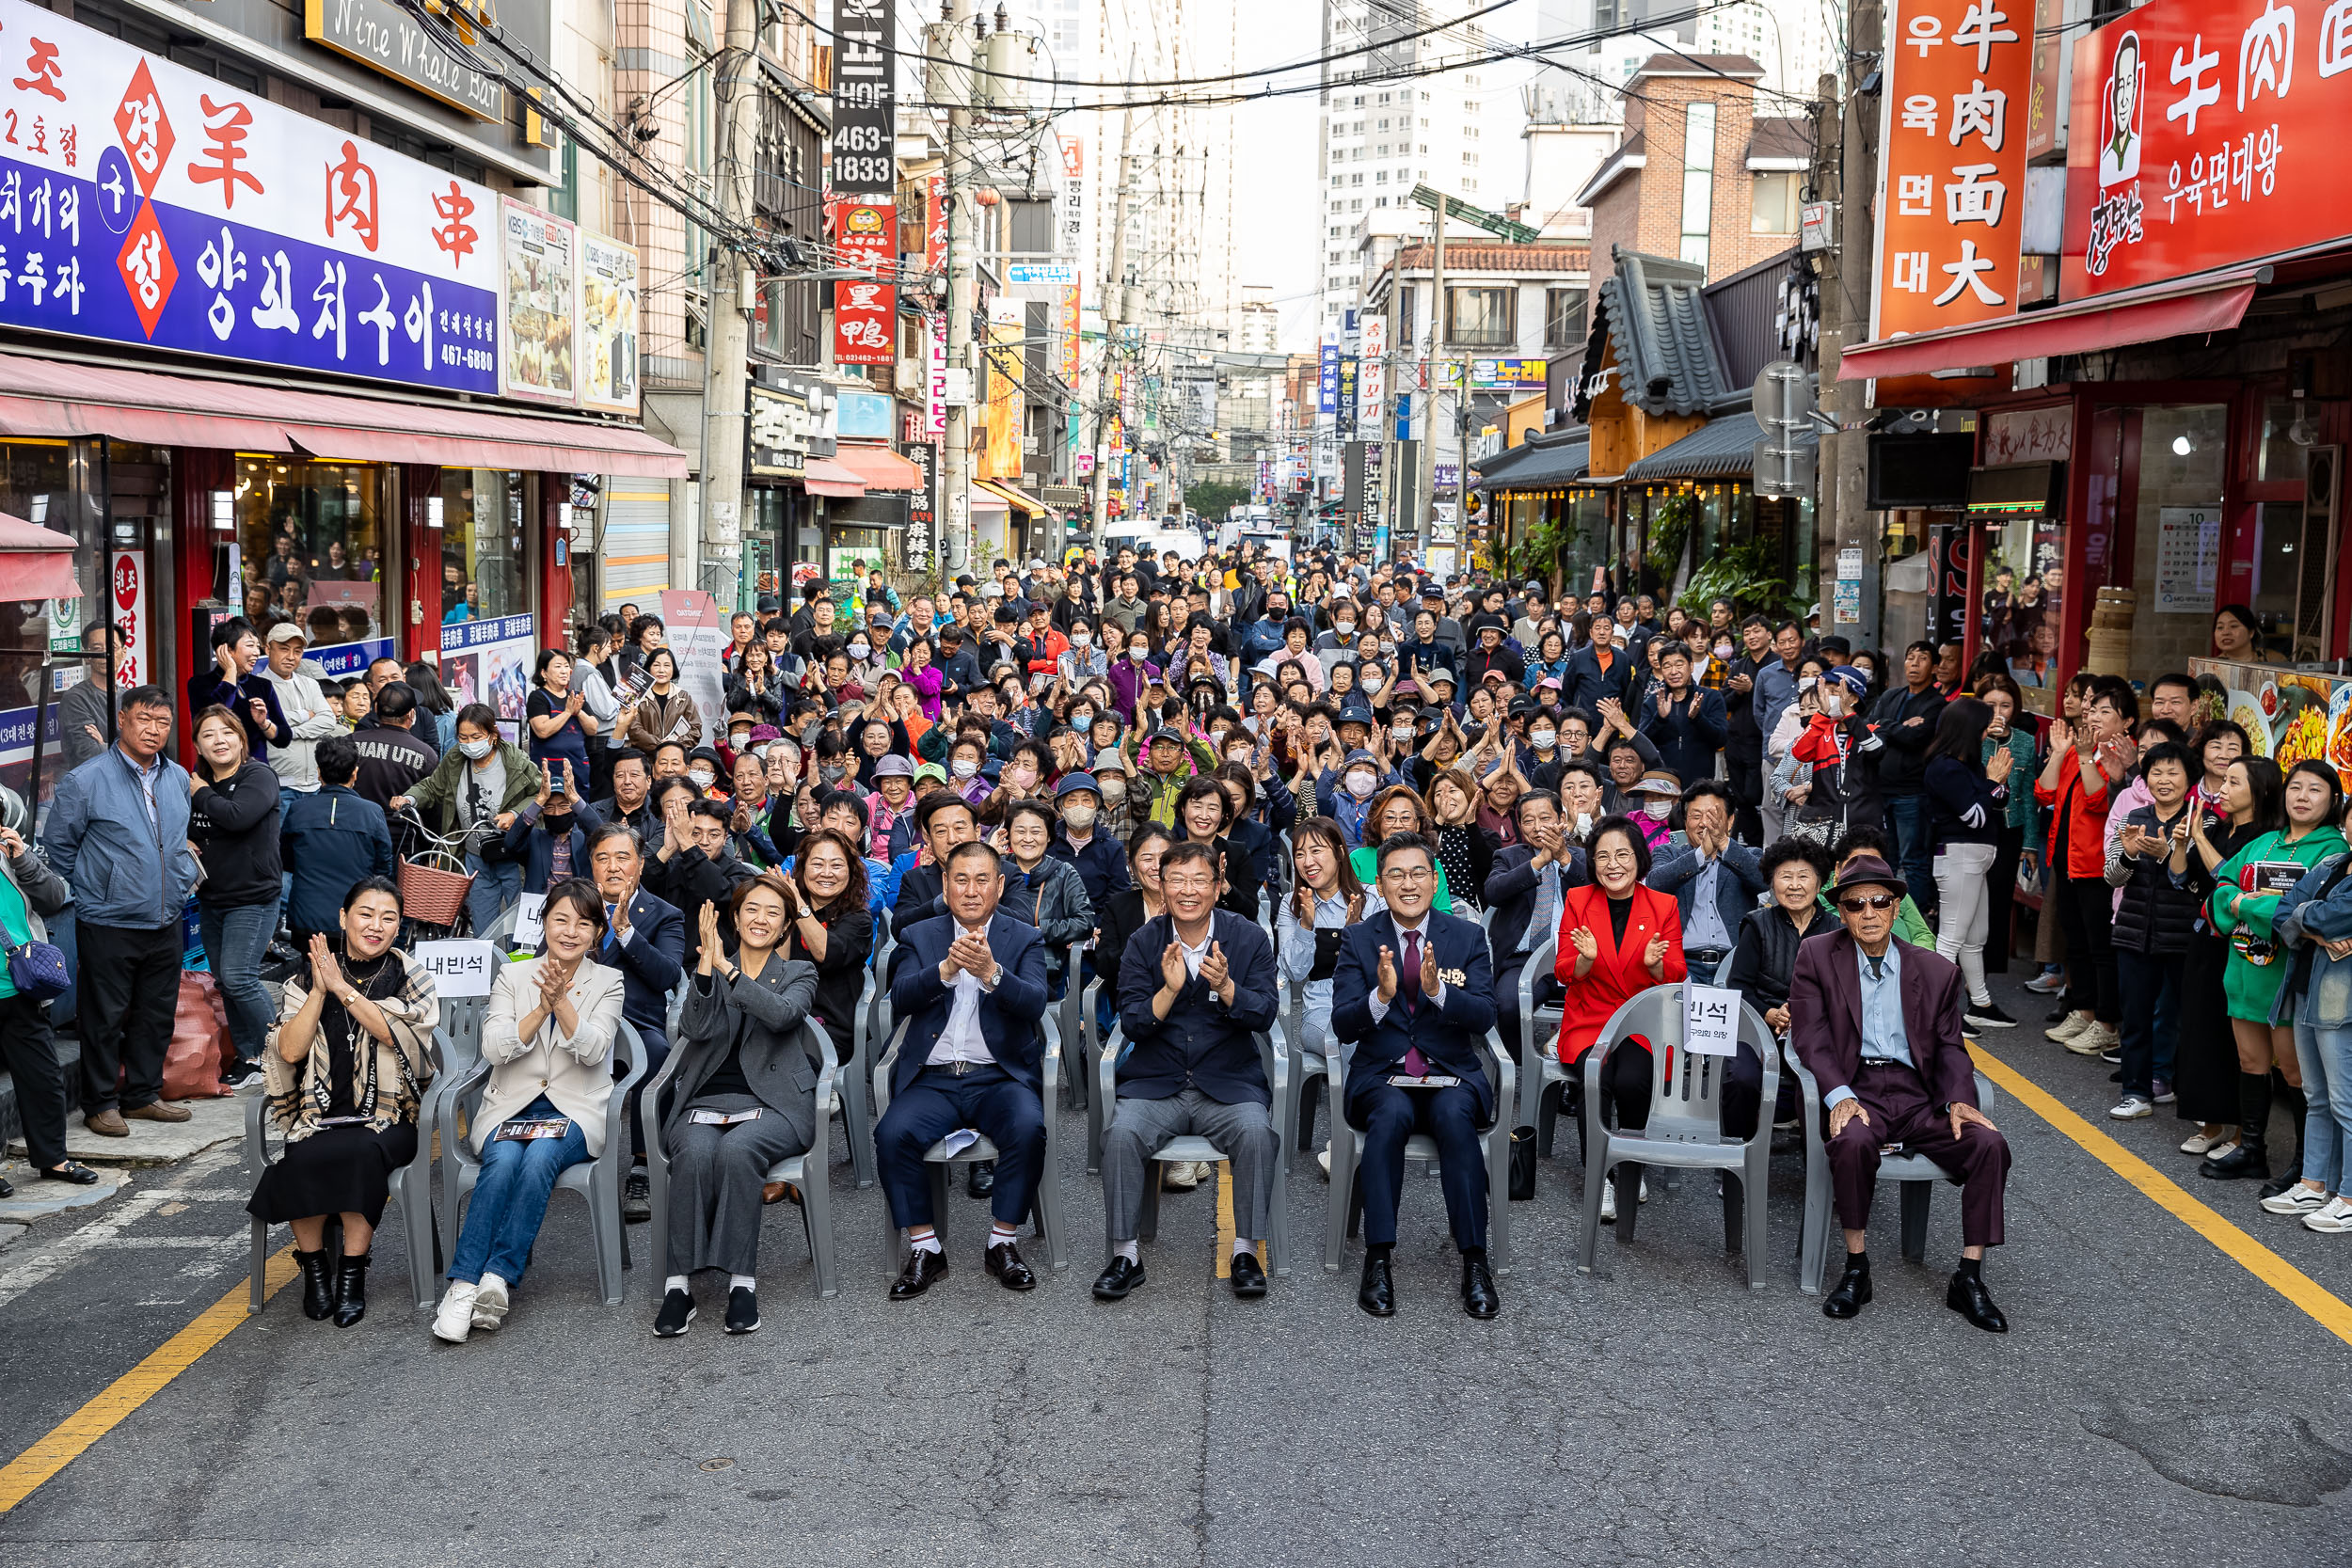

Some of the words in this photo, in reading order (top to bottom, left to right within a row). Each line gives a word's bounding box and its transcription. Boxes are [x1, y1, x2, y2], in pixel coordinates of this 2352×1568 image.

[467, 67, 500, 110] Bar
[838, 81, 889, 110] HOF
[834, 125, 892, 151] 463-
[187, 93, 479, 270] 羊肉串
[834, 156, 890, 182] 1833
[1891, 15, 1944, 337] 우육면대
[2163, 123, 2283, 226] 우육면대왕
[196, 226, 434, 372] 양꼬치구이
[441, 343, 493, 372] 467-6880
[1497, 360, 1546, 382] 노래
[2189, 513, 2204, 525] 10
[115, 568, 136, 595] 원조
[0, 718, 59, 745] (3대천왕집)
[355, 741, 388, 758] MAN
[391, 745, 425, 770] UTD
[426, 956, 483, 975] 내빈석
[1713, 1030, 1728, 1039] 의장
